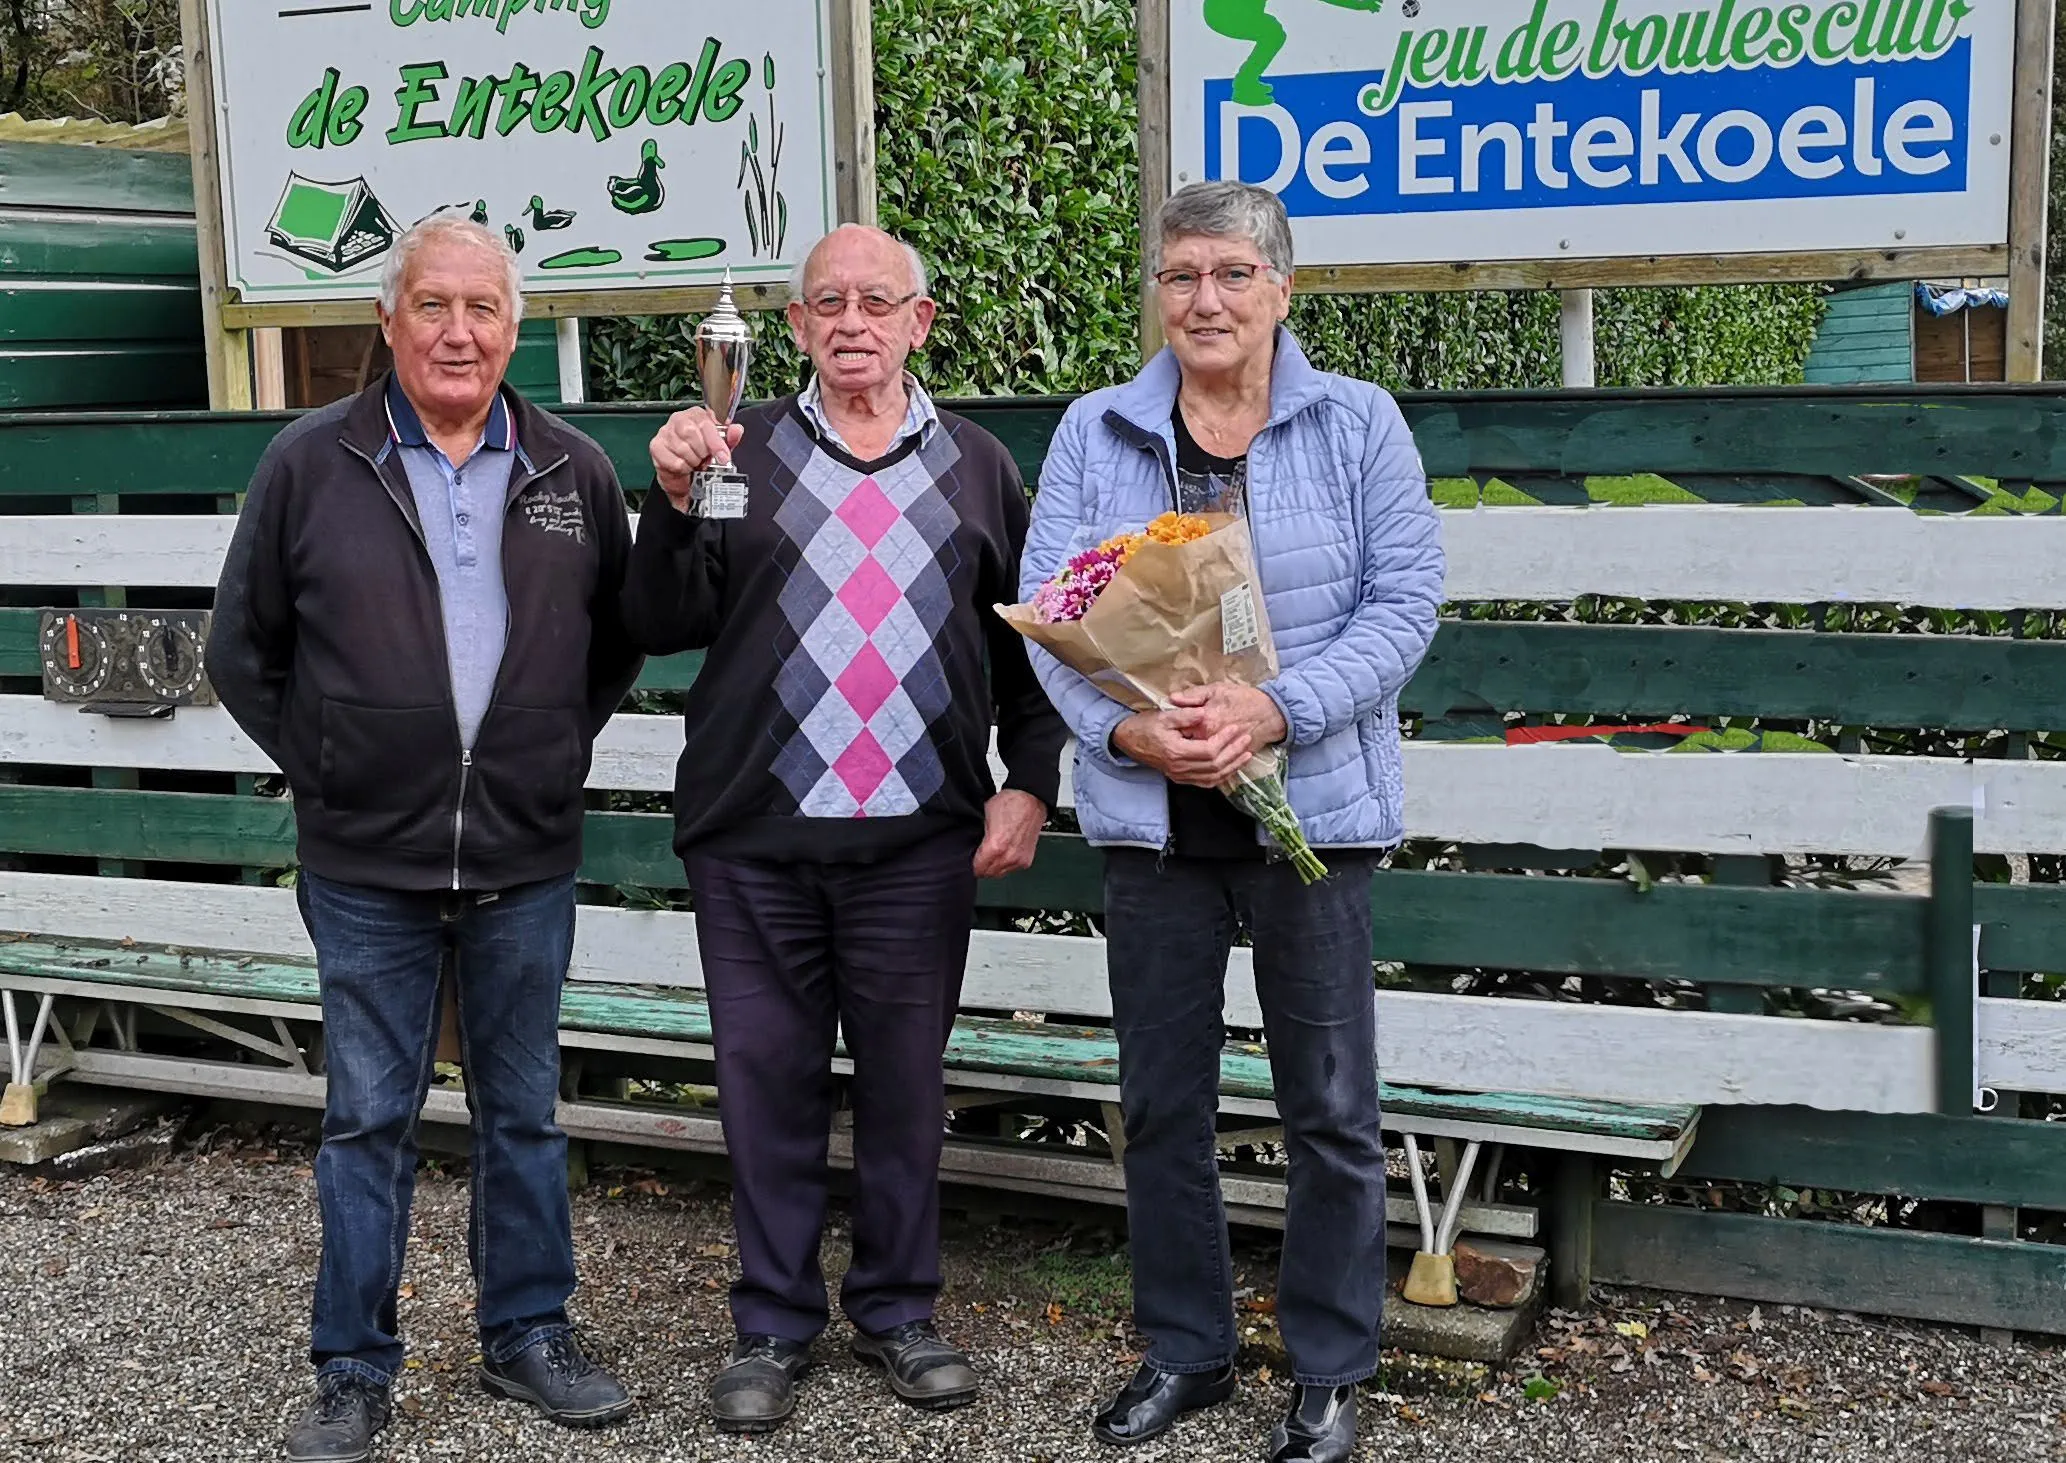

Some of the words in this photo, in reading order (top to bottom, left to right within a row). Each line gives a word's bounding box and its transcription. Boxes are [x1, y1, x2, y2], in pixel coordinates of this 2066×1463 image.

[286, 66, 369, 149] de
[385, 36, 751, 146] Entekoele
[1362, 0, 1488, 112] jeu
[1495, 0, 1585, 77] de
[1219, 99, 1372, 200] De
[1398, 77, 1954, 195] Entekoele
